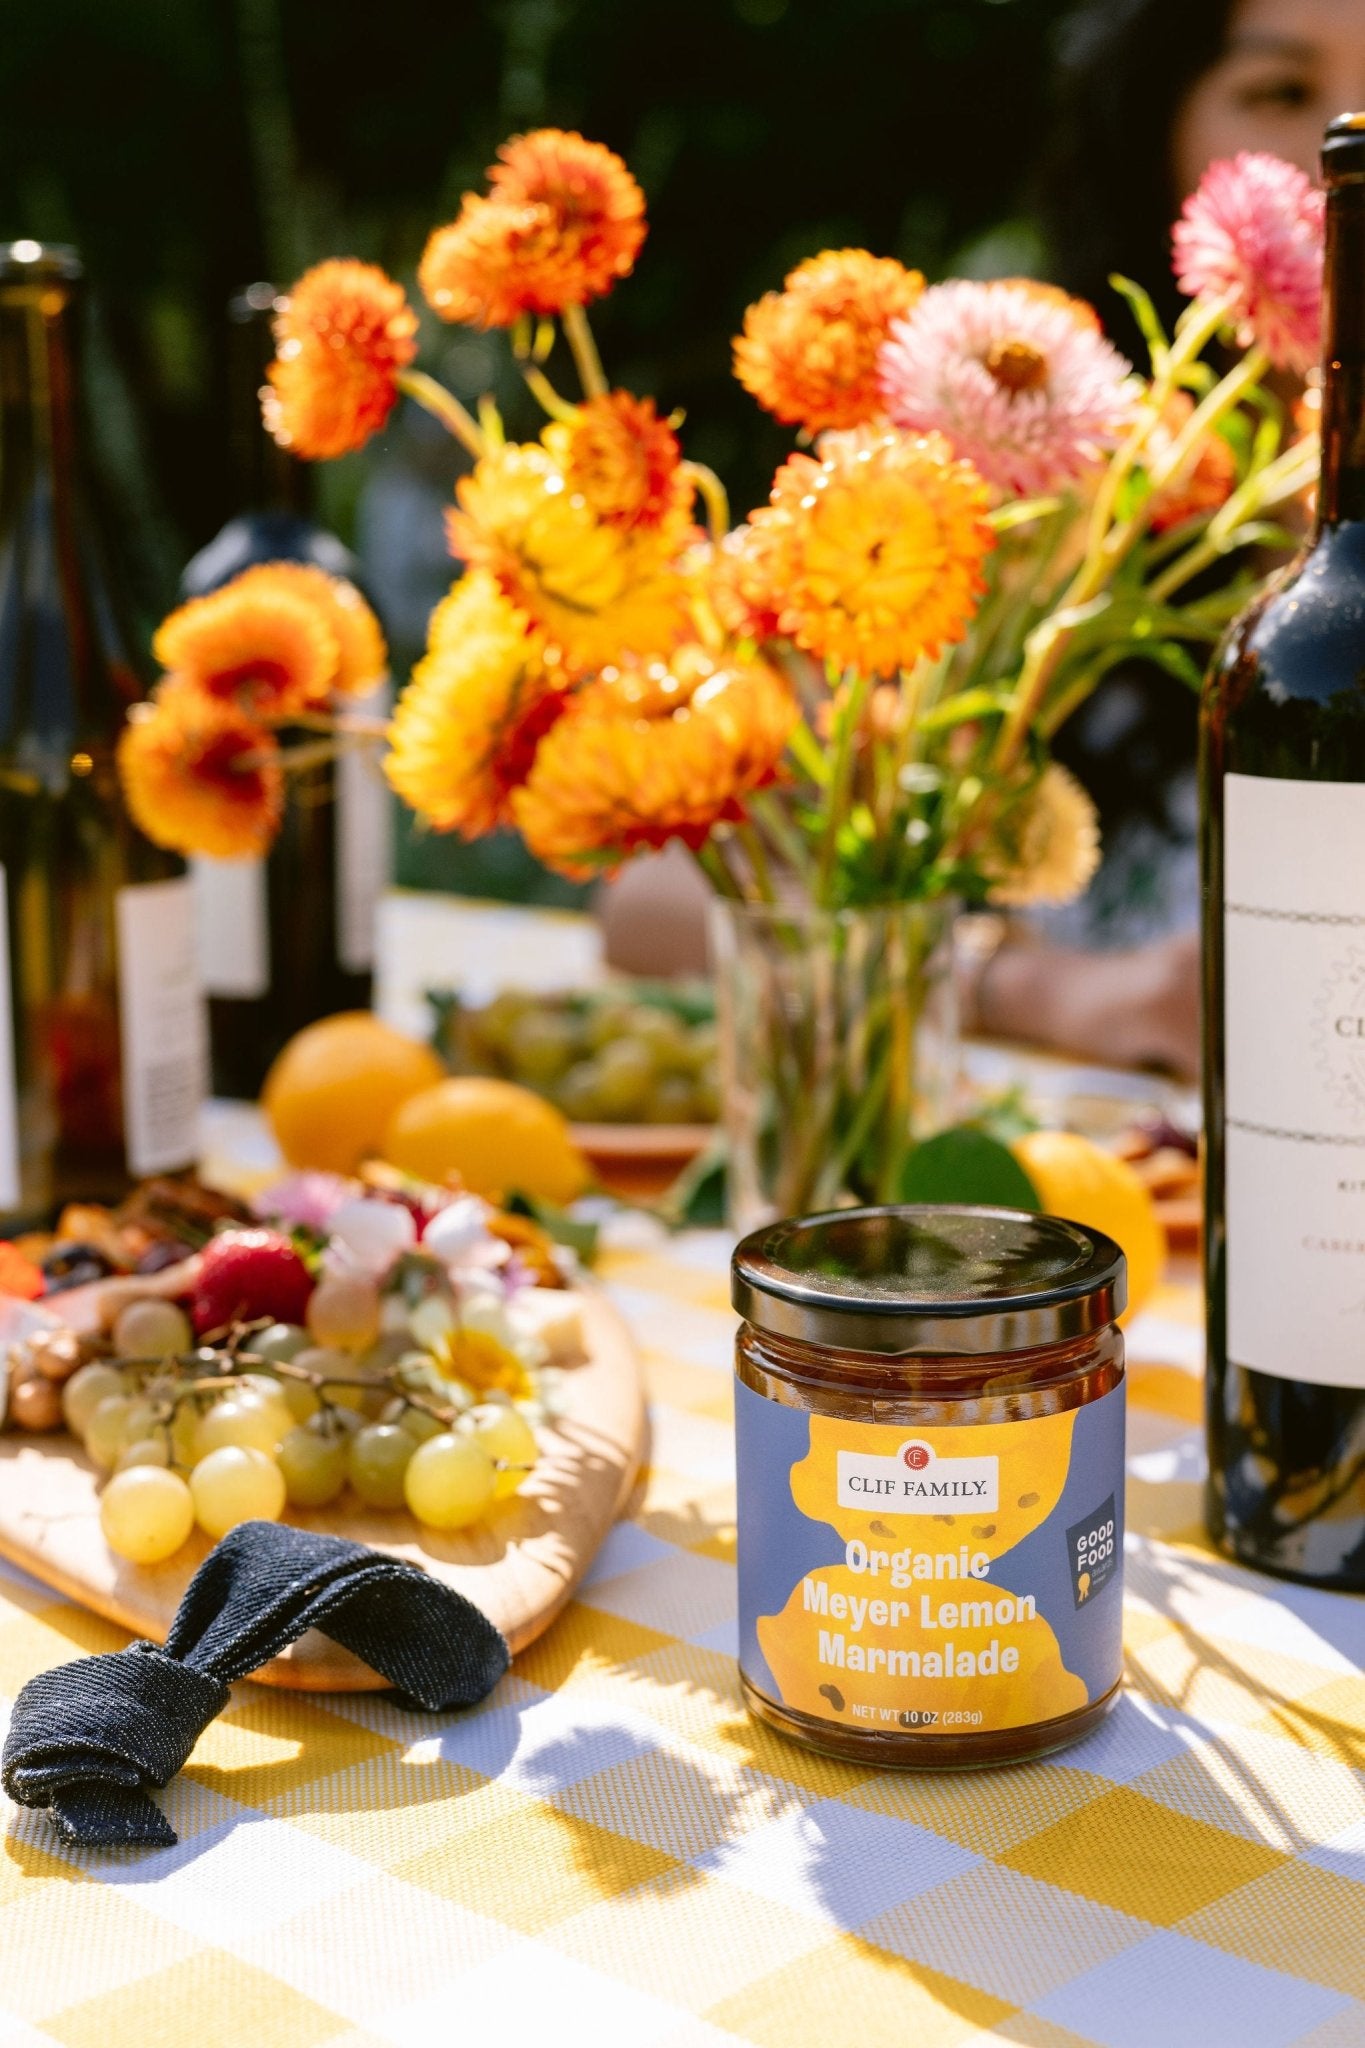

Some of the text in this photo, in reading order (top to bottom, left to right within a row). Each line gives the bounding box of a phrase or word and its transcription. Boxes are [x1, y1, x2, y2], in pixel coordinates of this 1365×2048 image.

[848, 1476, 896, 1495] CLIF
[1076, 1519, 1114, 1552] GOOD
[845, 1539, 990, 1589] Organic
[1077, 1538, 1114, 1572] FOOD
[802, 1576, 1036, 1632] Meyer Lemon
[818, 1629, 1020, 1678] Marmalade
[852, 1703, 983, 1726] NET WT 10 OZ (283g)
